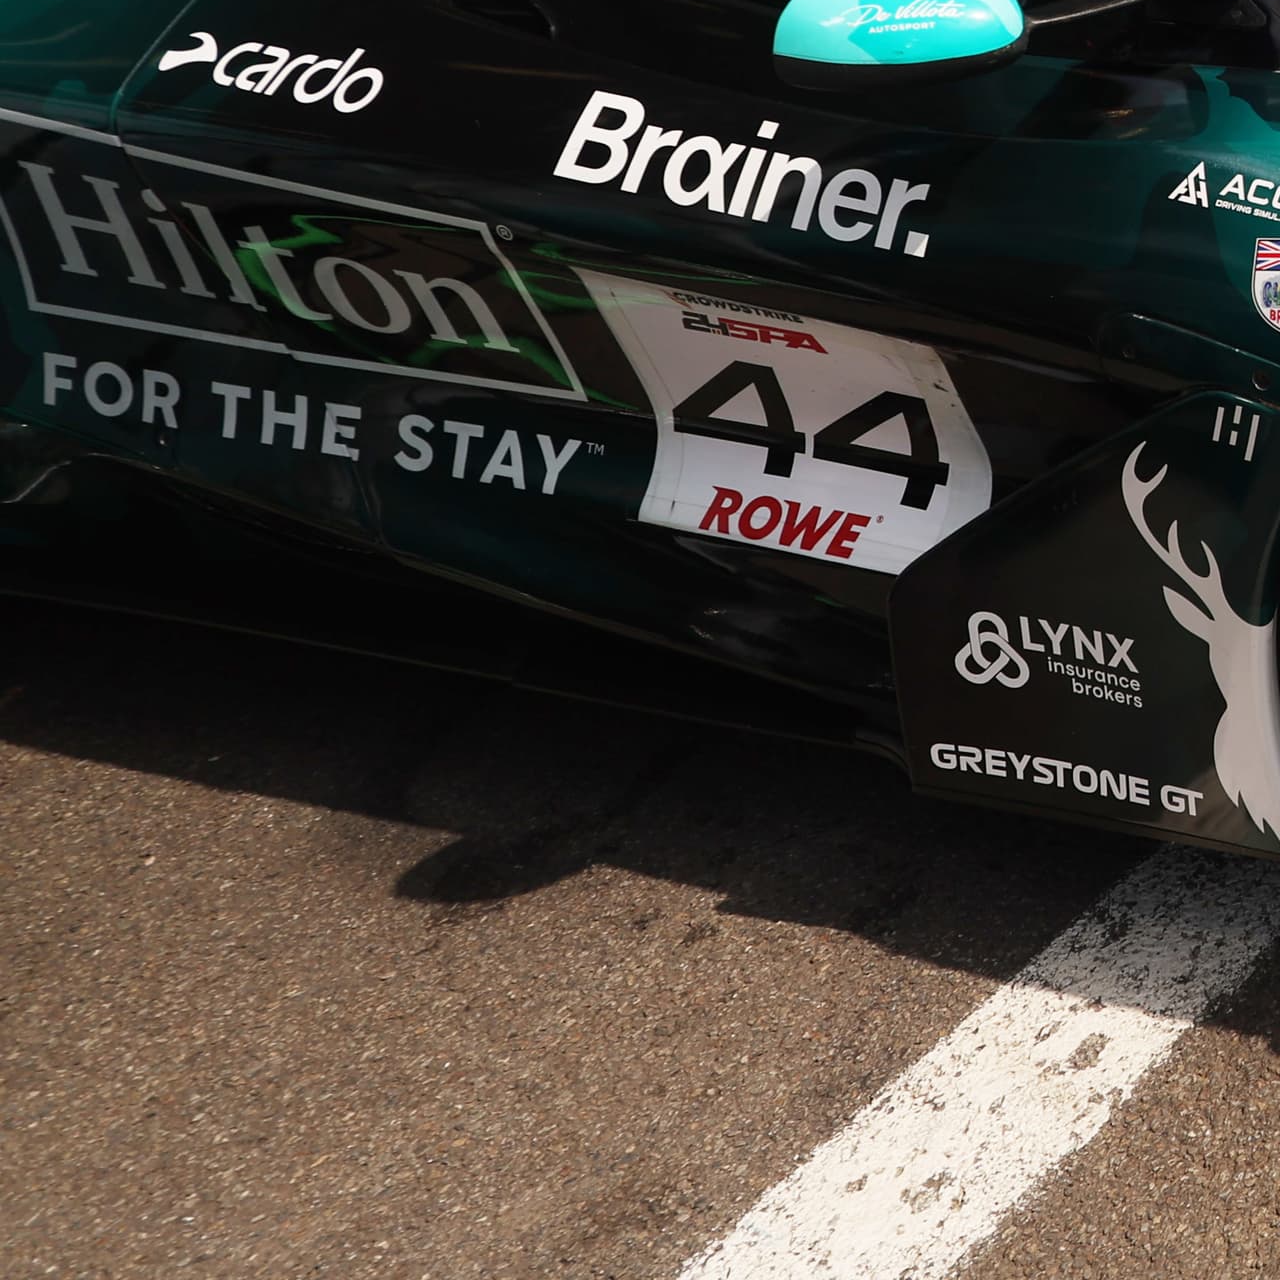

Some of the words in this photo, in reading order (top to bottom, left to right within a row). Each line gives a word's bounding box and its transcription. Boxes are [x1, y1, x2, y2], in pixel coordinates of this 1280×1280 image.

[868, 21, 937, 35] AUTOSPORT
[212, 44, 384, 114] cardo
[553, 90, 931, 259] Brainer.
[1215, 199, 1253, 215] DRIVING
[18, 160, 520, 354] Hilton
[672, 291, 804, 324] CROWDSTRIKE
[42, 352, 181, 430] FOR
[209, 382, 363, 463] THE
[393, 412, 583, 496] STAY
[672, 359, 952, 511] 44
[698, 485, 874, 561] ROWE
[1018, 614, 1140, 674] LYNX
[1047, 657, 1142, 693] insurance
[1071, 677, 1144, 709] brokers
[929, 742, 1151, 807] GREYSTONE
[1159, 783, 1204, 817] GT
